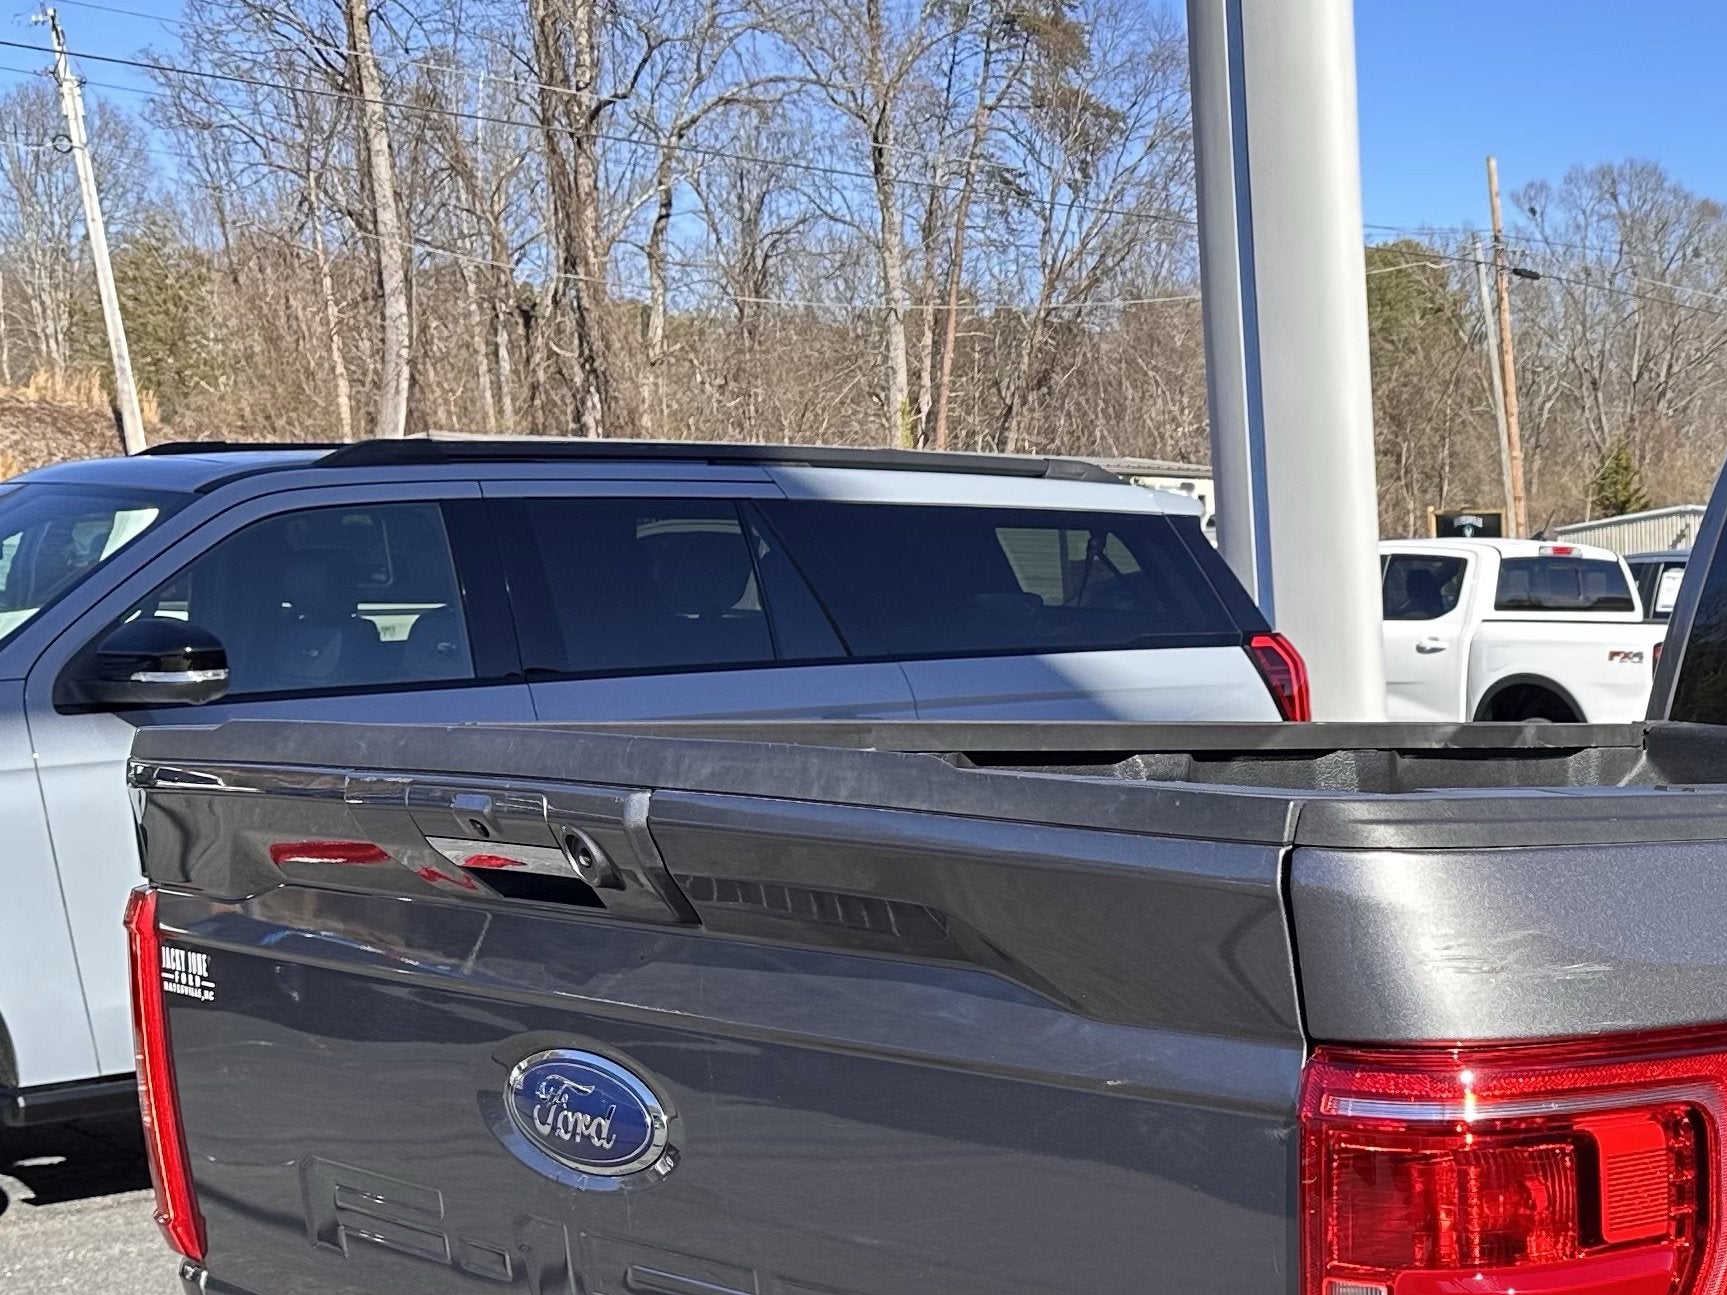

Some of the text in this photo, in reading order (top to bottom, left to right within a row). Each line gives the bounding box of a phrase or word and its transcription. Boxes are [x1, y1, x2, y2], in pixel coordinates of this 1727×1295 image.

[1608, 650, 1644, 662] FX4
[161, 946, 211, 977] JACKY JONE
[174, 970, 201, 987] FORD
[533, 1074, 617, 1149] Ford
